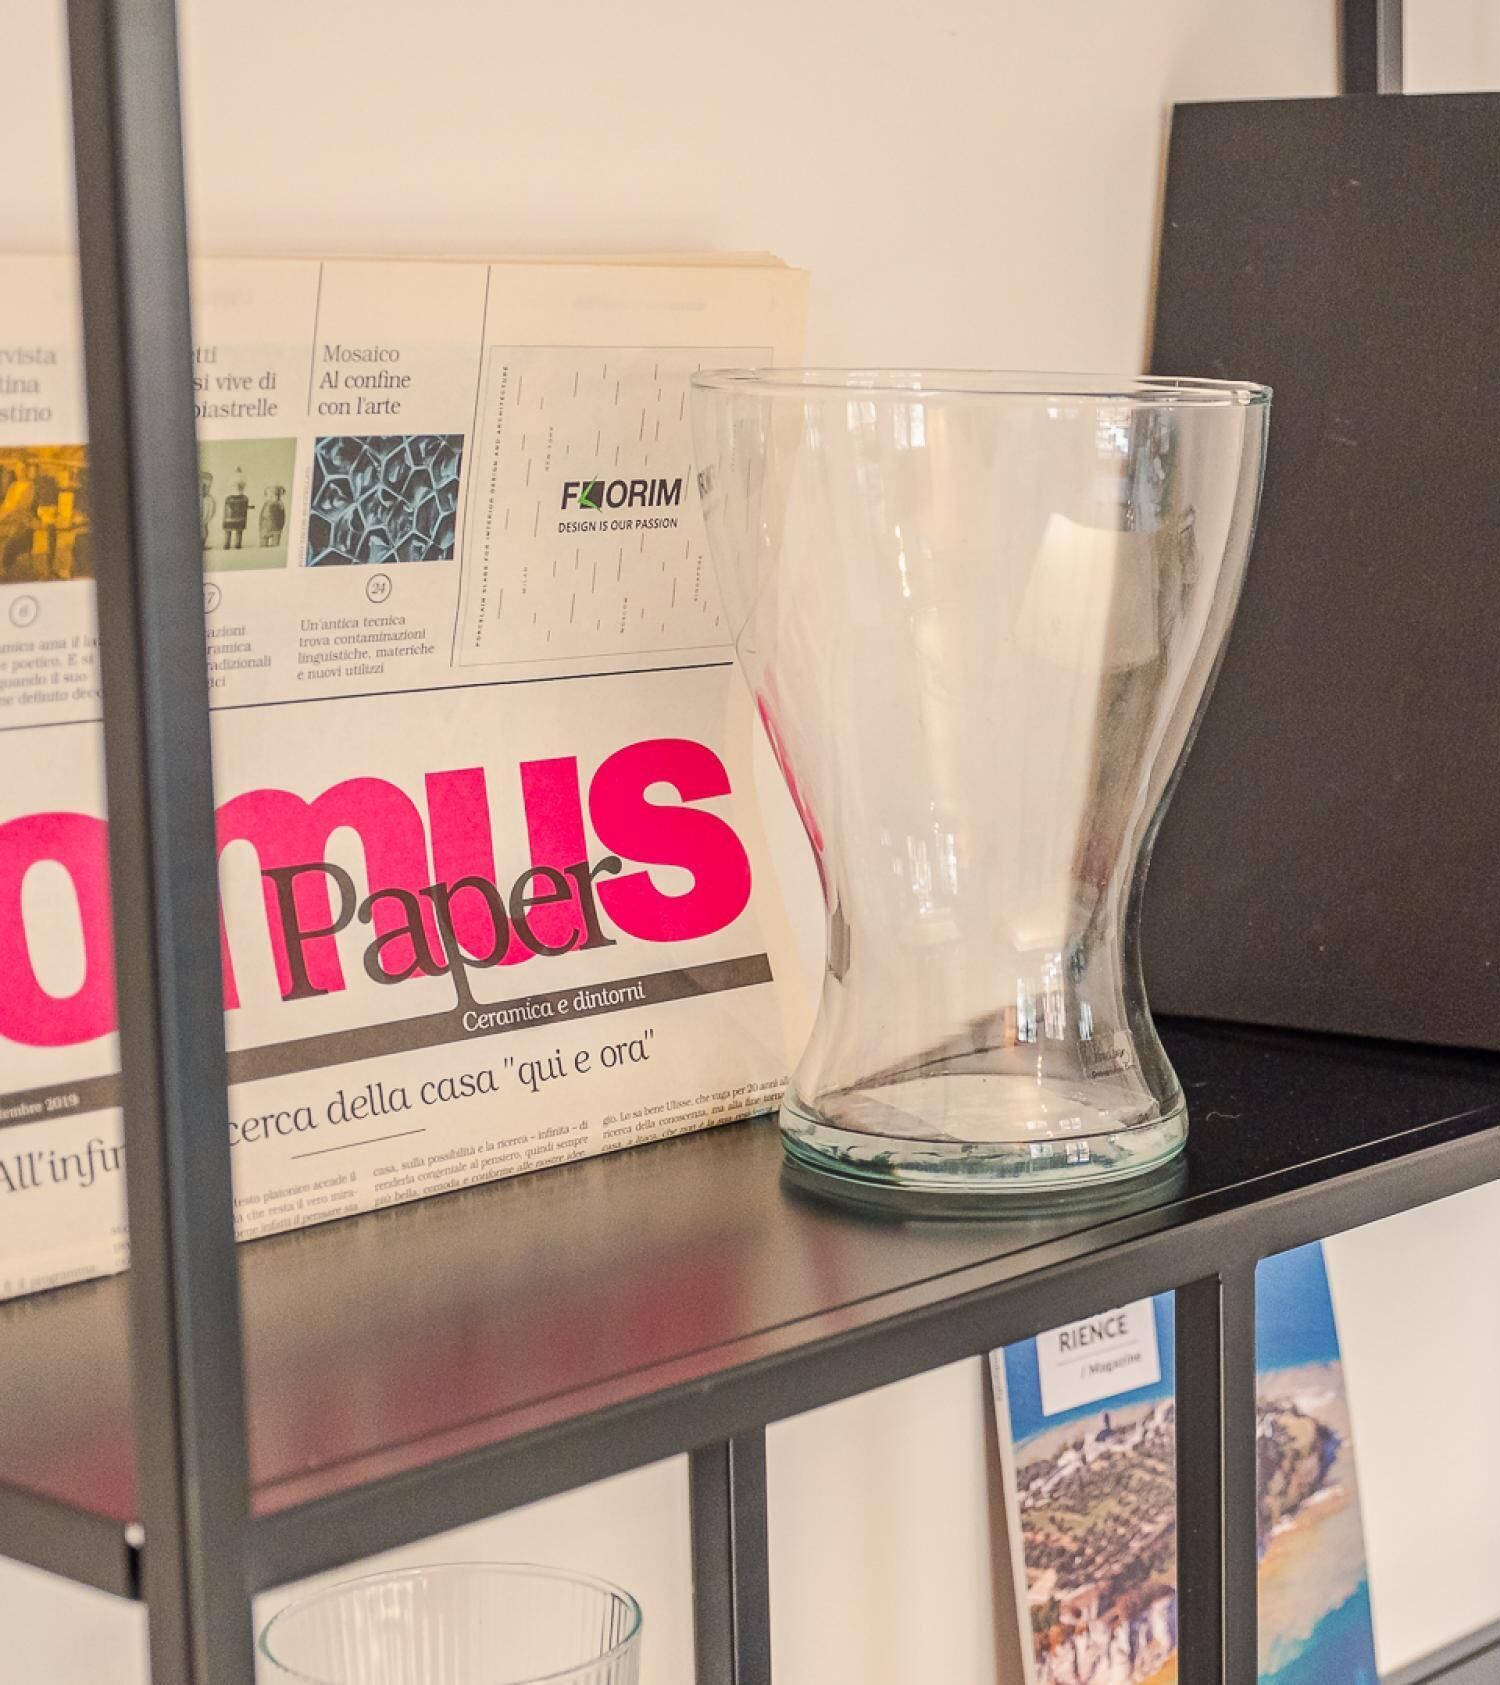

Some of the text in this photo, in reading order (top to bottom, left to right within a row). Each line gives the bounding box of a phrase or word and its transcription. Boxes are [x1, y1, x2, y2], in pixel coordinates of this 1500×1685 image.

[323, 345, 400, 362] Mosaico
[216, 376, 252, 391] vive
[259, 371, 276, 390] di
[319, 370, 411, 389] Al confine
[318, 397, 400, 415] con l'arte
[558, 517, 678, 533] DESIGN IS OUR PASSION
[371, 582, 387, 595] 24
[363, 616, 406, 627] tecnica
[299, 629, 426, 648] trova contaminazioni
[375, 643, 435, 658] materiche
[296, 662, 384, 681] e nuovi utilizzi
[261, 854, 623, 1008] Paper
[463, 981, 645, 1032] Ceramica e dintorni
[327, 1082, 413, 1126] della
[421, 1069, 499, 1105] casa
[574, 1049, 591, 1073] e
[45, 1093, 80, 1112] 2019
[644, 1104, 664, 1115] bene
[732, 1086, 746, 1099] per
[747, 1083, 759, 1093] 20
[579, 1120, 589, 1131] di
[1059, 1314, 1128, 1353] RIENCE
